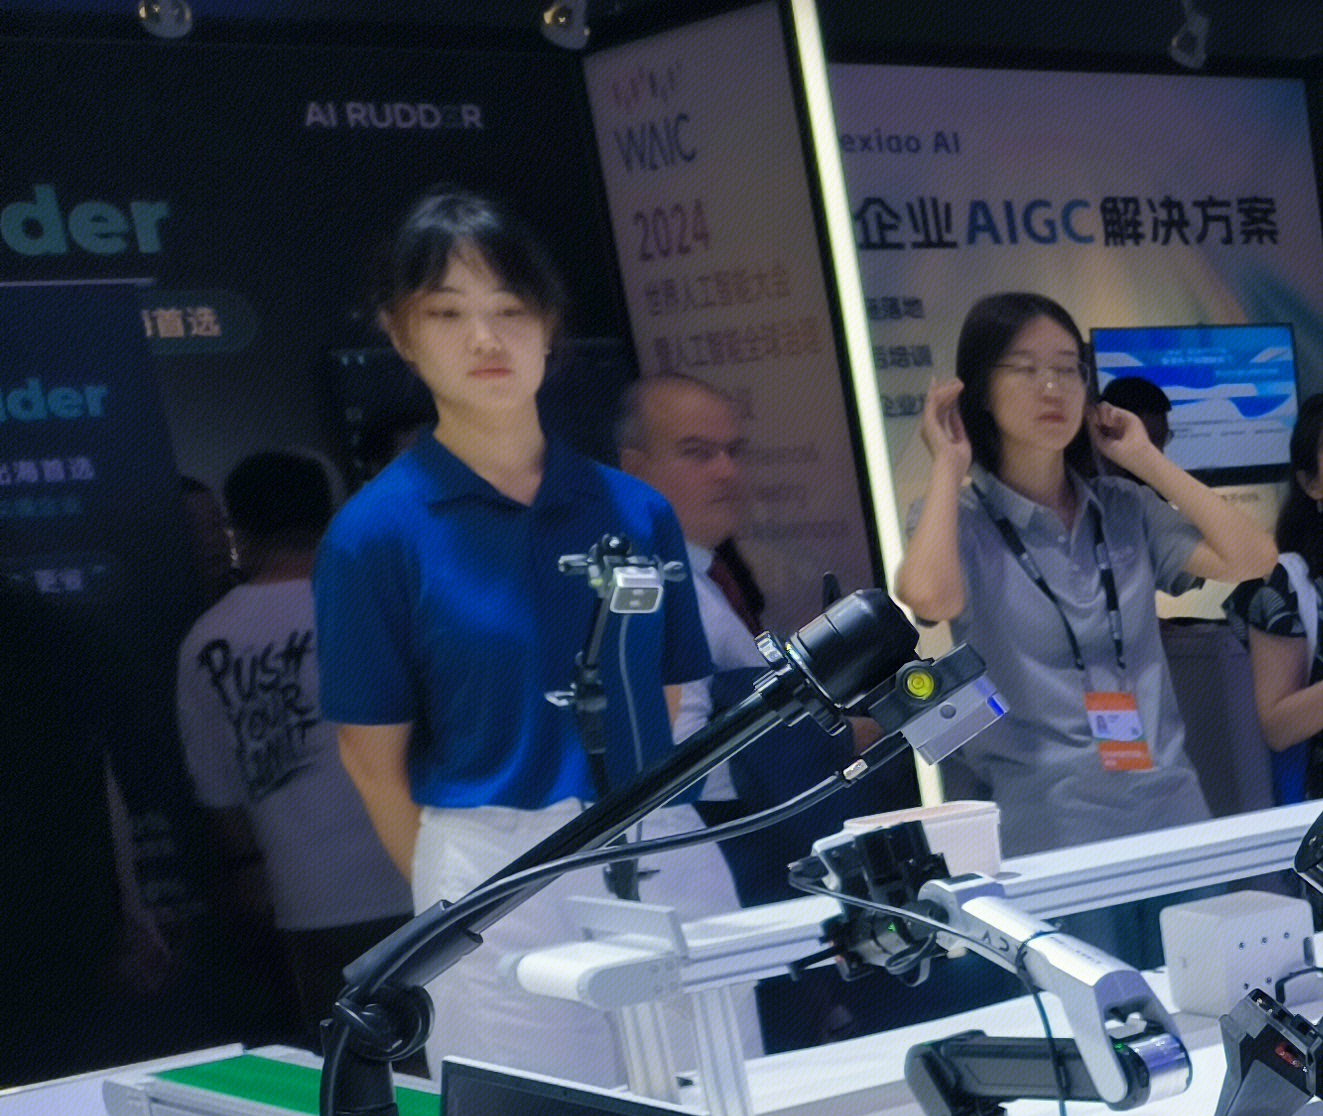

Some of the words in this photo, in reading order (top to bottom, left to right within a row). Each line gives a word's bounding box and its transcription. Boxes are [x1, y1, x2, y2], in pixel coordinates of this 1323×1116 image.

[304, 102, 337, 127] AI
[614, 114, 697, 174] WAIC
[934, 131, 960, 153] AI
[634, 199, 710, 263] 2024
[854, 195, 1280, 251] 企业AIGC解决方案
[0, 377, 108, 423] der
